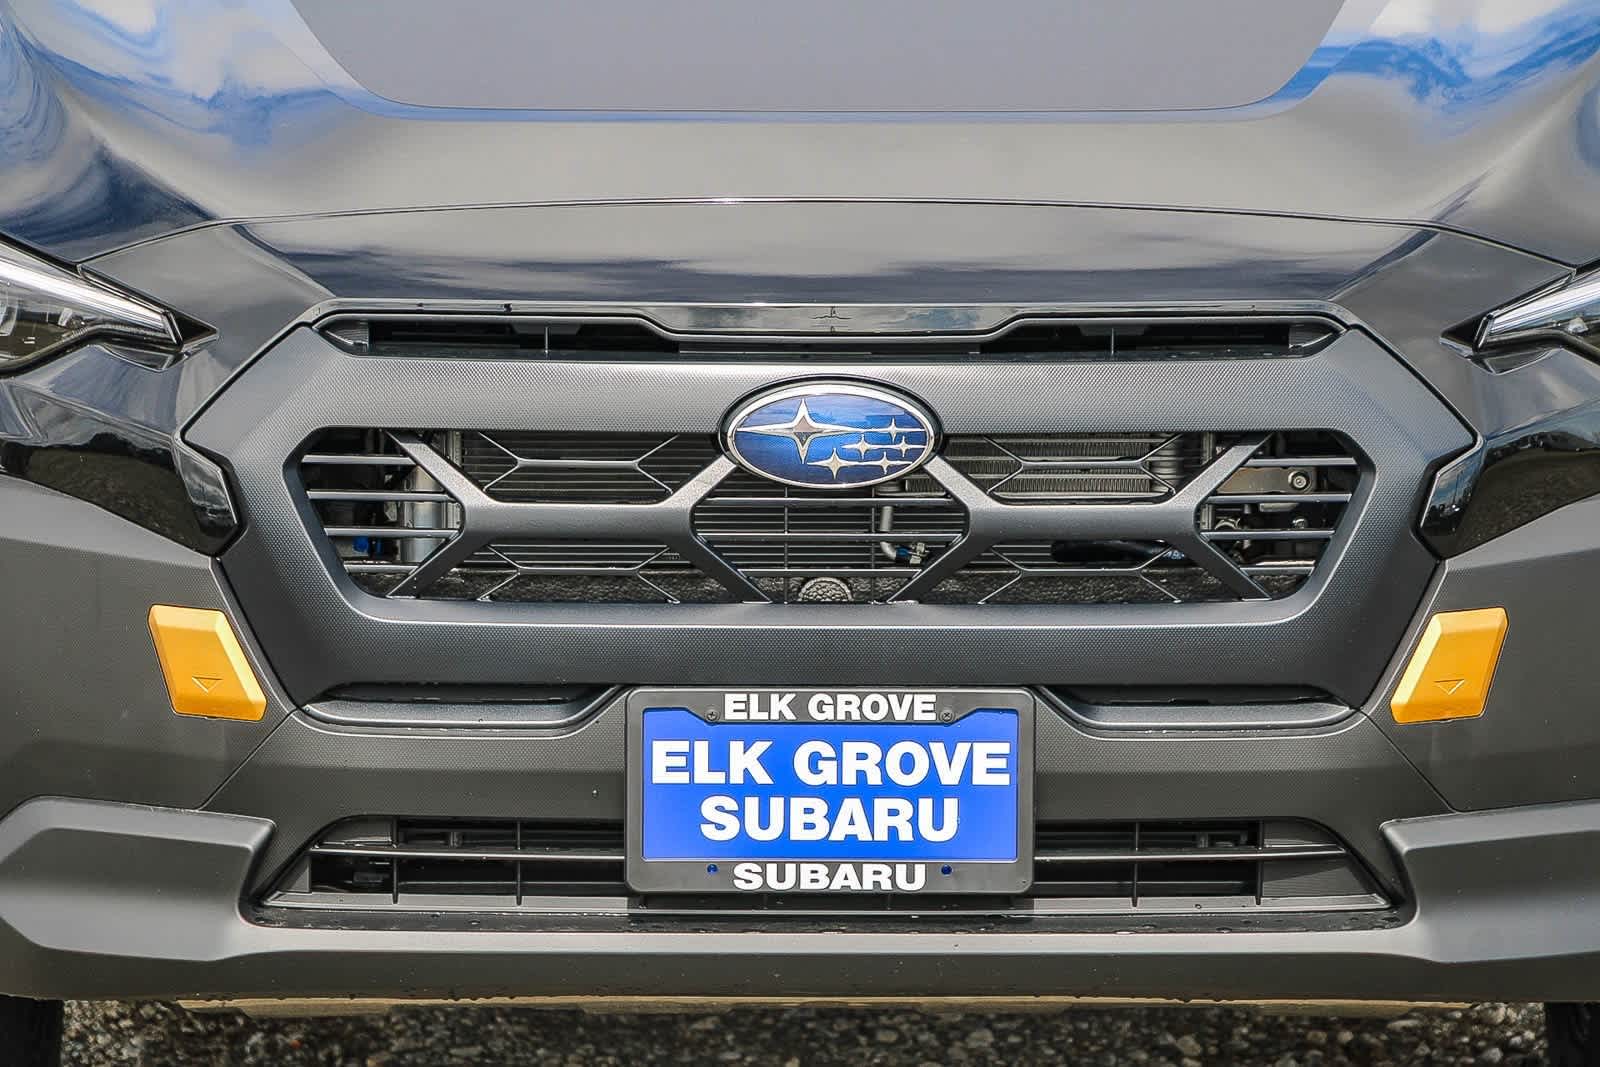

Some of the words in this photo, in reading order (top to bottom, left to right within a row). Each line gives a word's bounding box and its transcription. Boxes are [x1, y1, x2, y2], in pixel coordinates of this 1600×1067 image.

[724, 693, 797, 721] ELK
[807, 693, 937, 721] GROVE
[652, 740, 774, 785] ELK
[793, 740, 1011, 786] GROVE
[700, 795, 960, 842] SUBARU
[733, 862, 926, 891] SUBARU
